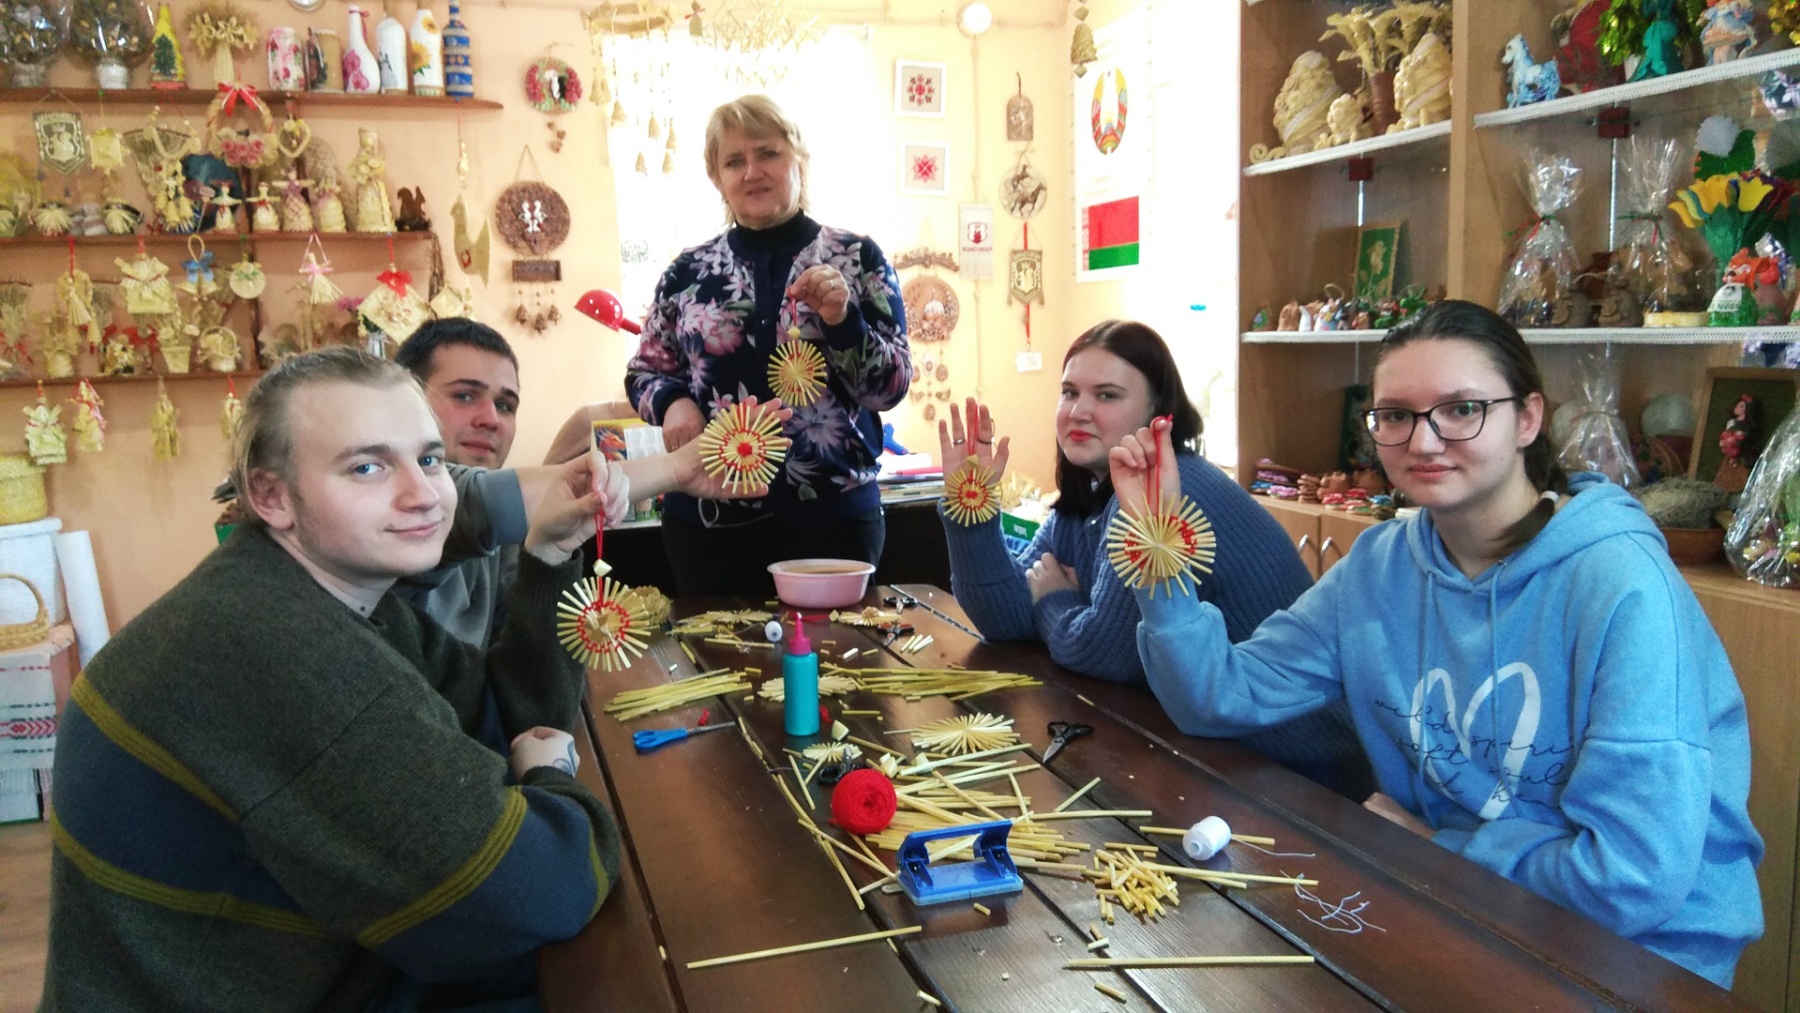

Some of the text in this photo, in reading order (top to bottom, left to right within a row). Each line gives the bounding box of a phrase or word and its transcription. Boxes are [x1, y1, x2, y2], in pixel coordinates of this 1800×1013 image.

[1398, 737, 1469, 771] soft
[1488, 761, 1570, 786] soul
[1471, 734, 1574, 758] spiri
